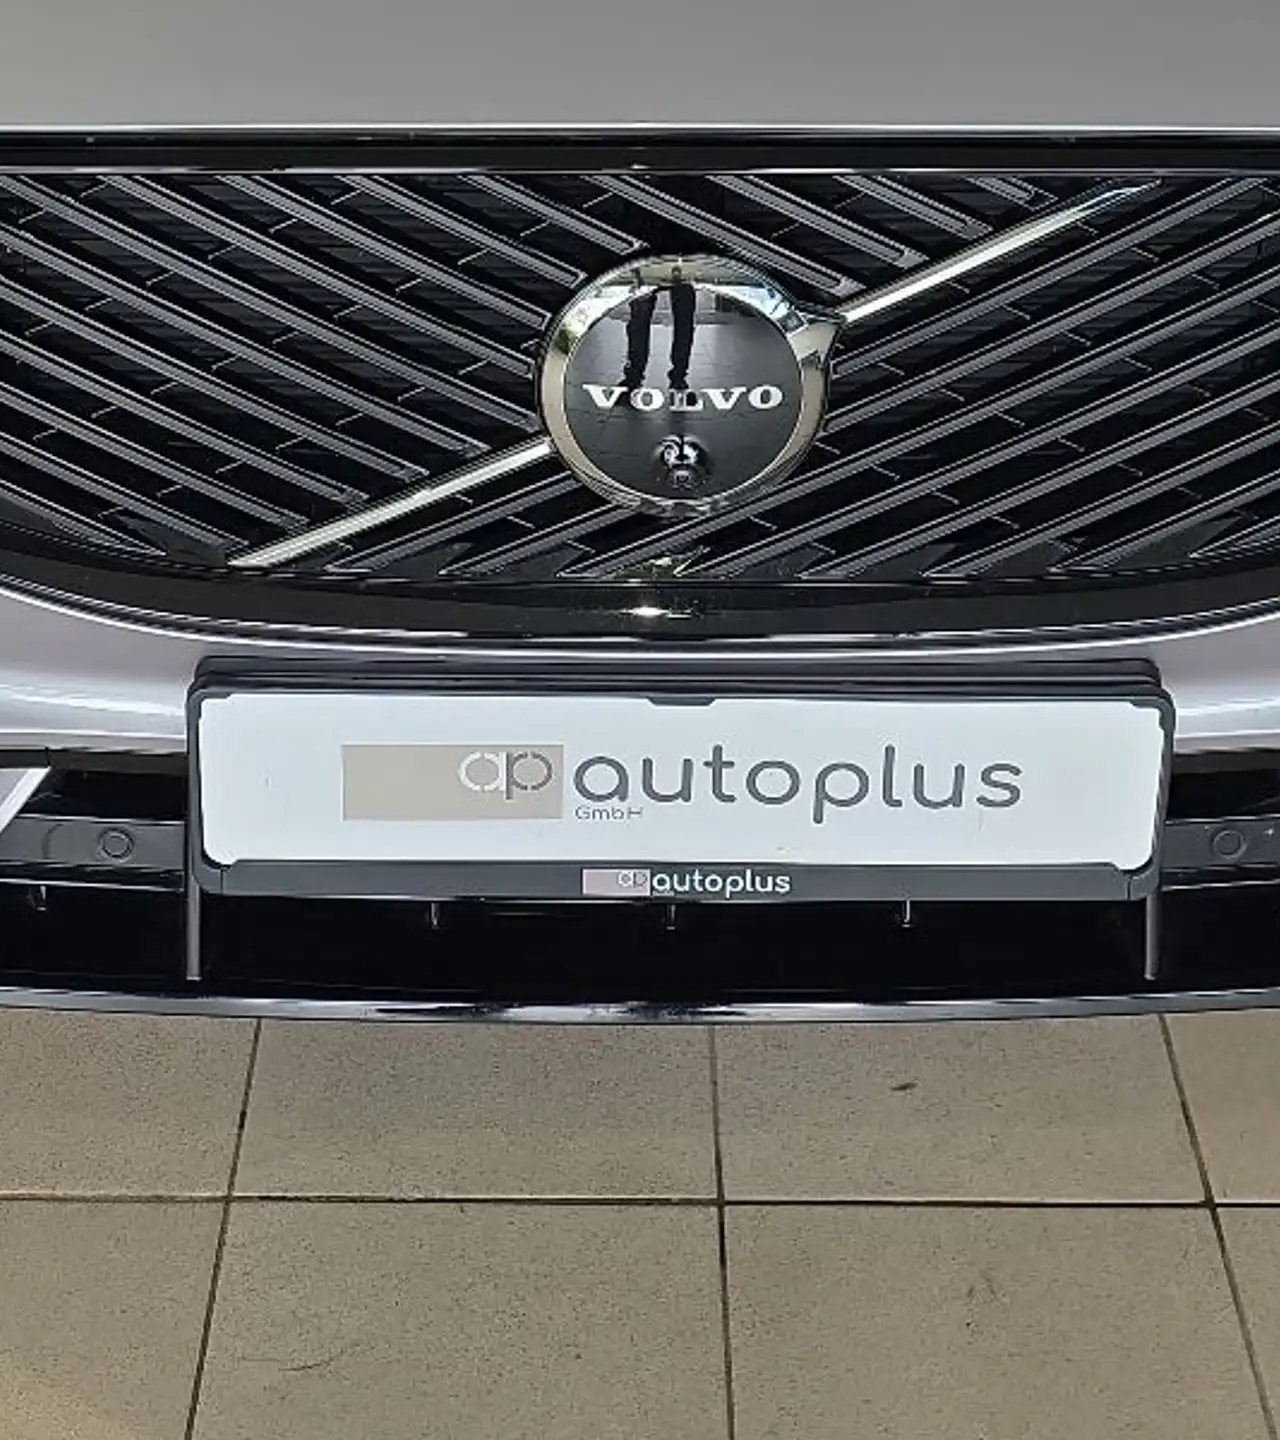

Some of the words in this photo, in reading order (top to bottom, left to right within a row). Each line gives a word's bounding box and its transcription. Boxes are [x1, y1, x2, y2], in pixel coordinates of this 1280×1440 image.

[582, 384, 784, 411] VOLVO
[573, 743, 1023, 824] autoplus
[575, 805, 644, 821] GmbH
[652, 868, 791, 899] autoplus
